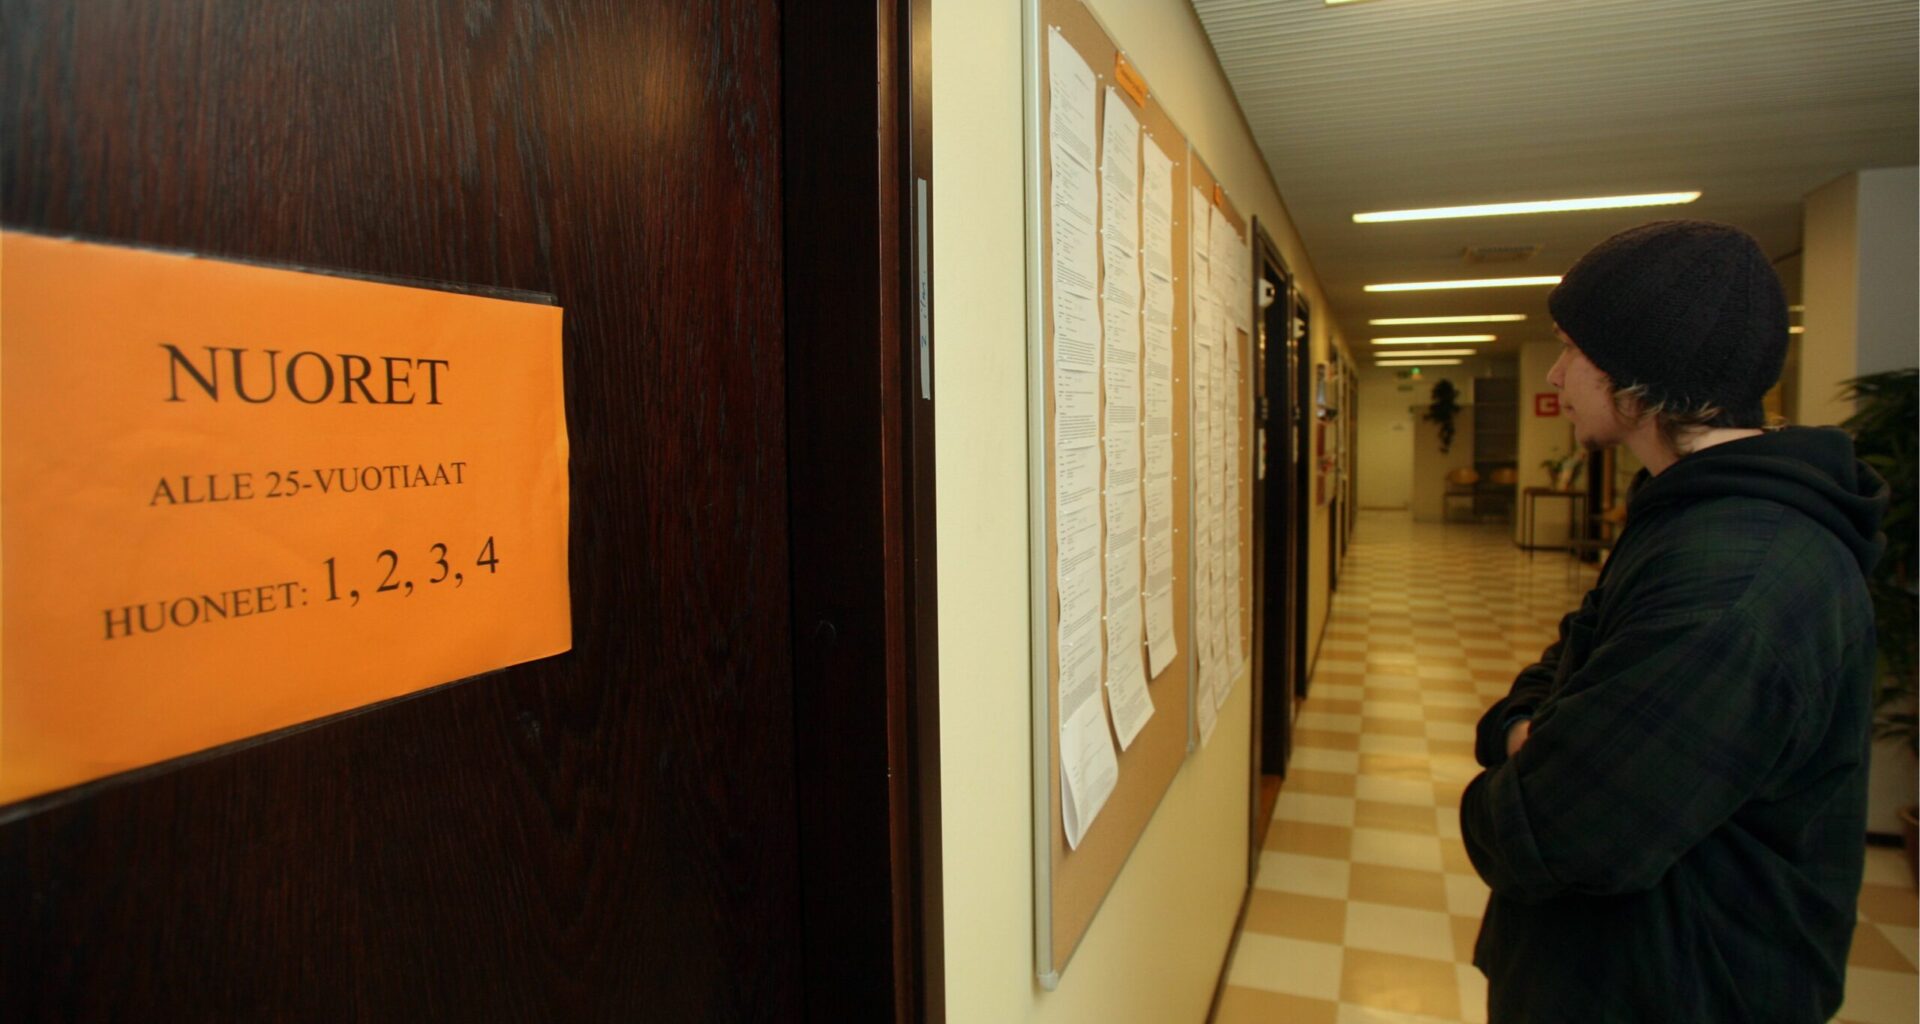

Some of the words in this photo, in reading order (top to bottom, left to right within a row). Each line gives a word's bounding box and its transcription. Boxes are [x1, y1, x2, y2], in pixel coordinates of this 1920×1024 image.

[159, 343, 450, 406] NUORET
[149, 473, 254, 506] ALLE
[266, 461, 467, 498] 25-VUOTIAAT
[104, 581, 308, 640] HUONEET:
[323, 557, 360, 607] 1,
[376, 548, 414, 597] 2,
[429, 542, 464, 587] 3,
[475, 535, 500, 574] 4
